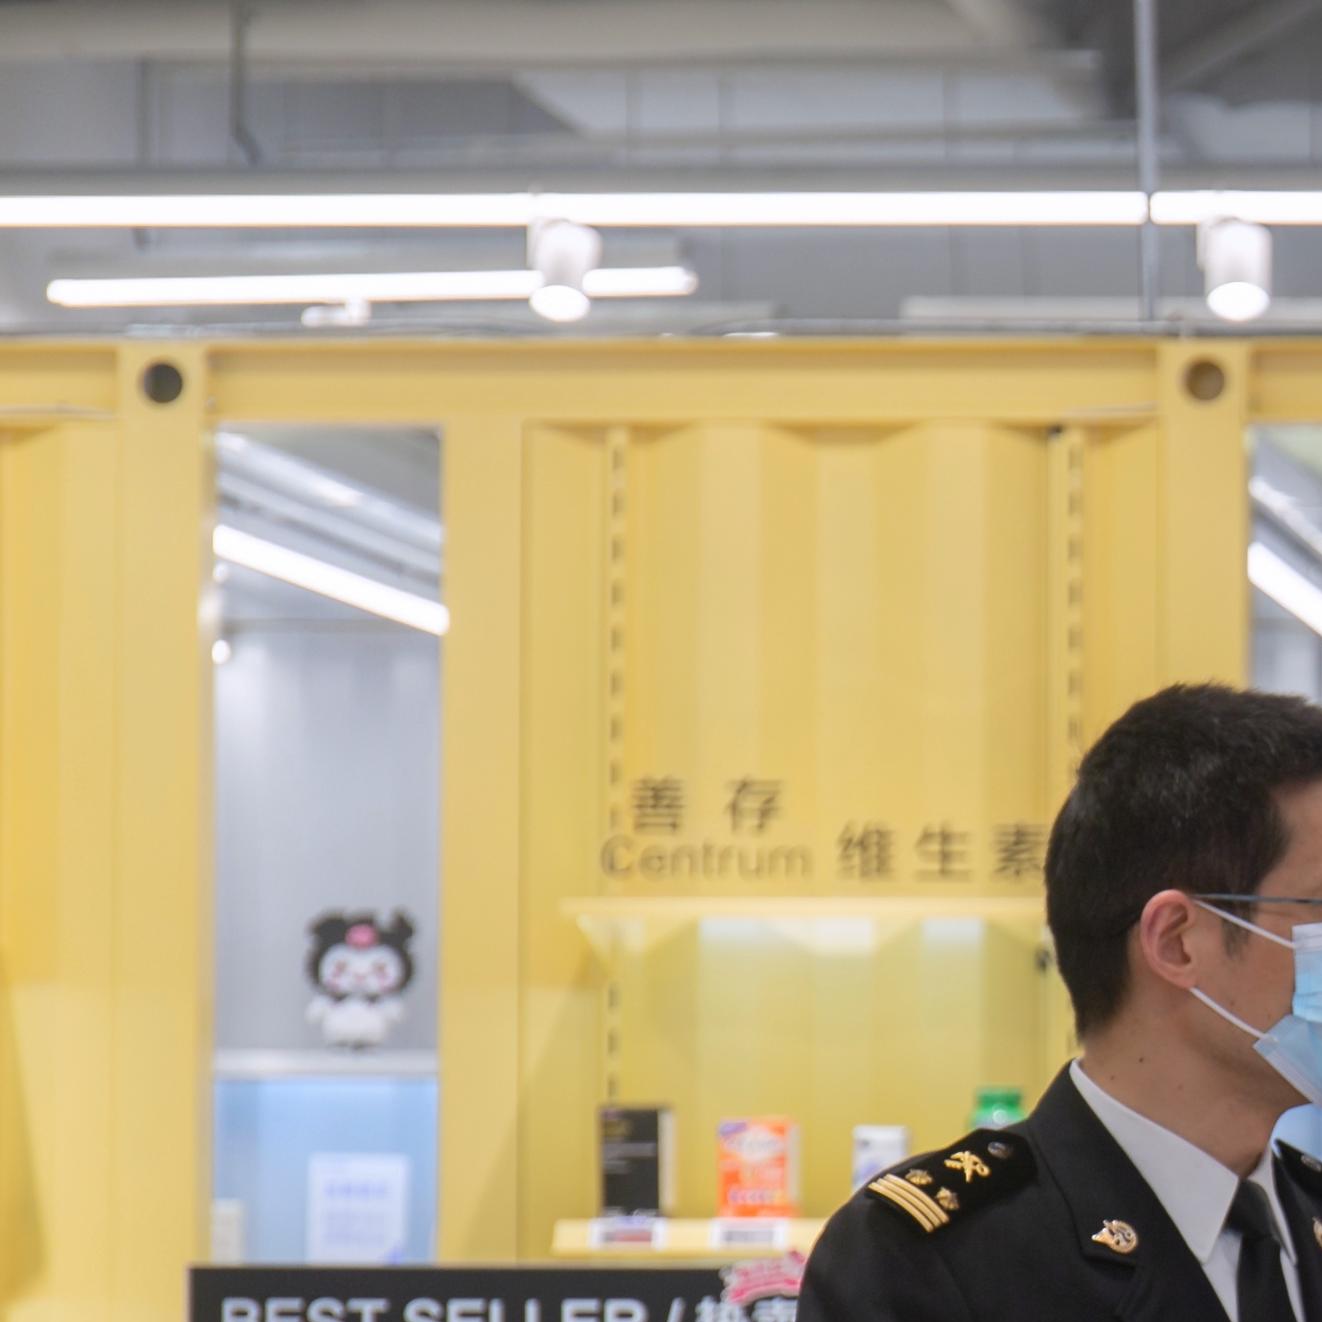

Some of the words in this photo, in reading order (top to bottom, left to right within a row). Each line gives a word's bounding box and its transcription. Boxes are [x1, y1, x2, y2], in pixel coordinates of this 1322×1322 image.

[632, 775, 786, 835] 善存
[601, 834, 817, 882] Centrum
[835, 820, 1047, 883] 维生素
